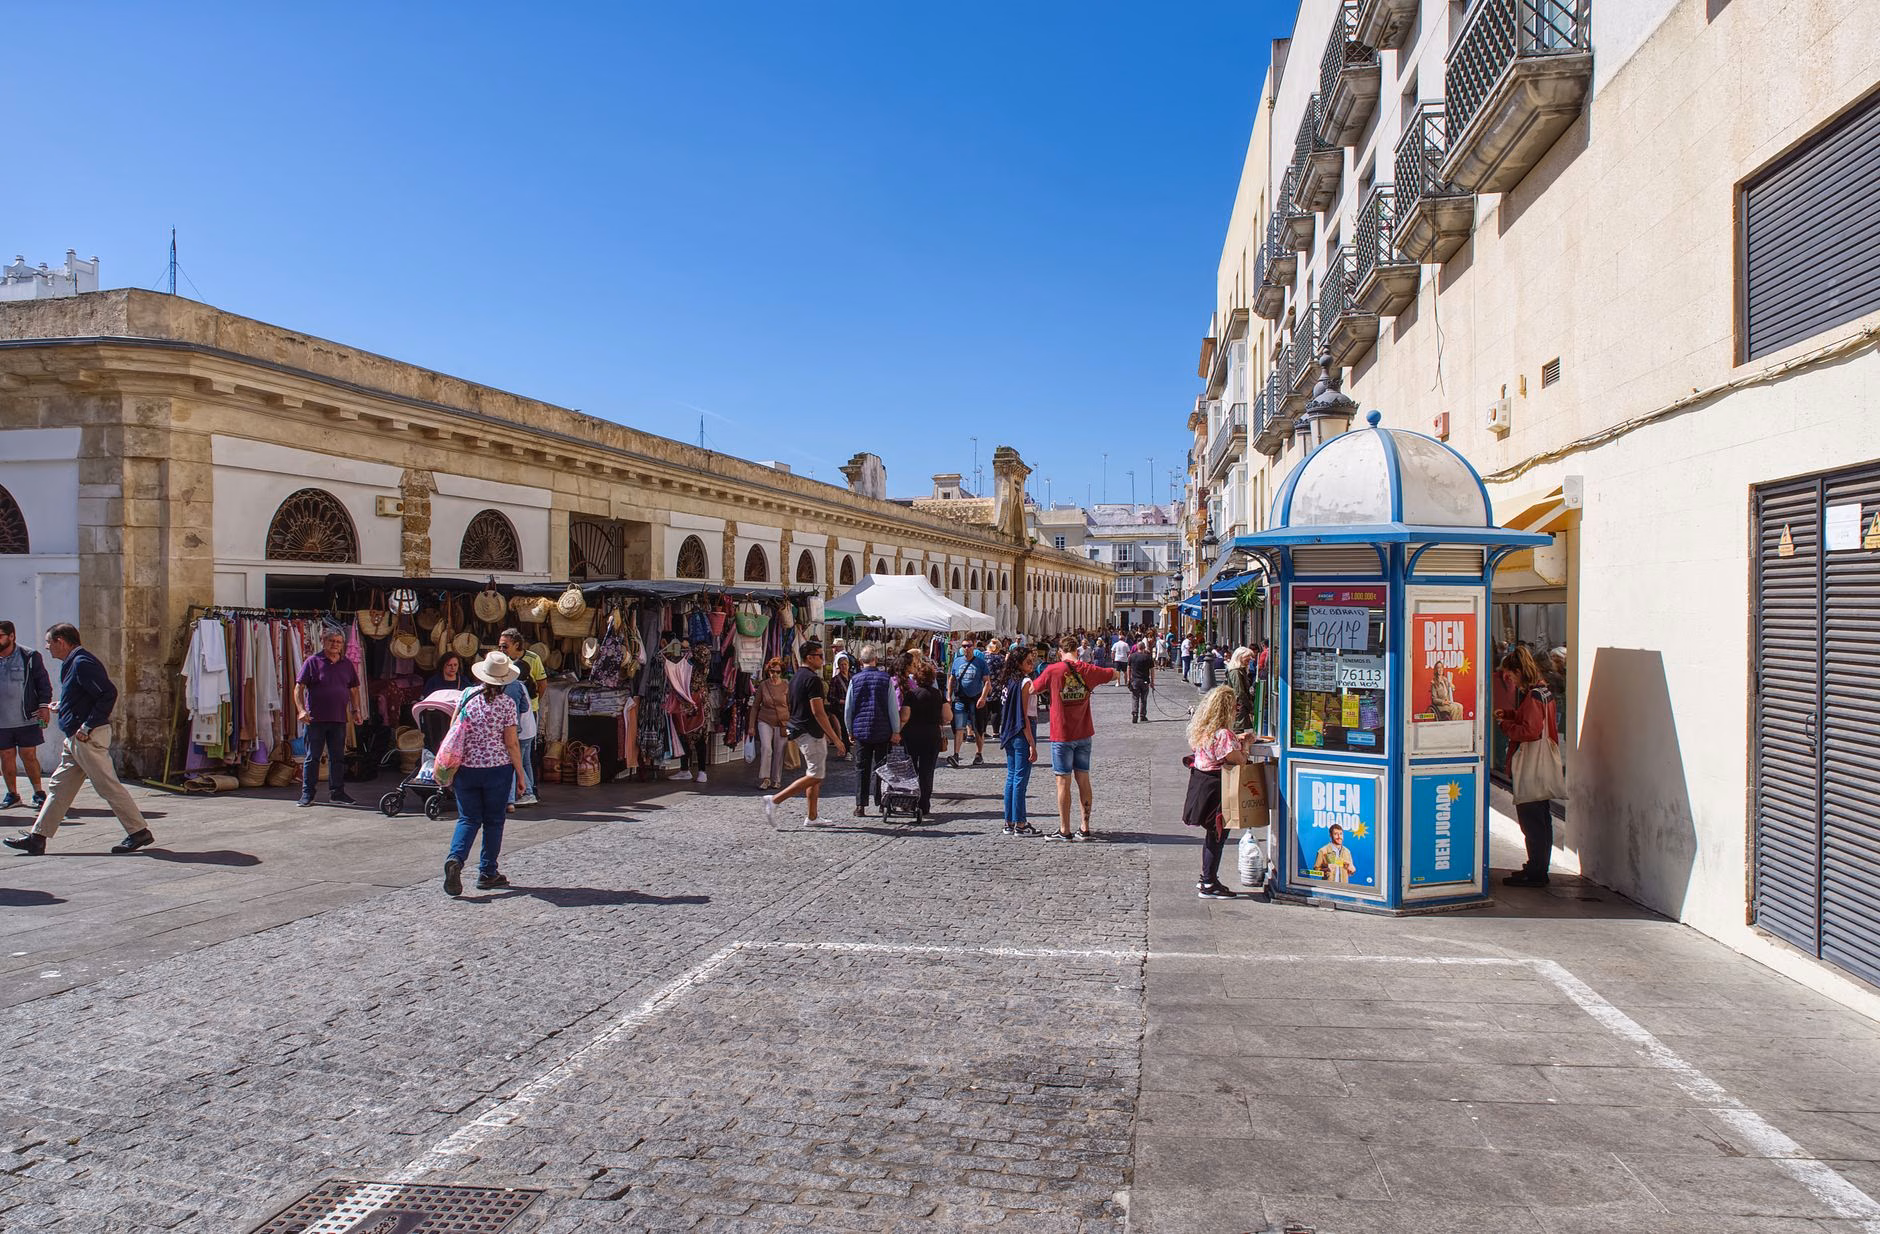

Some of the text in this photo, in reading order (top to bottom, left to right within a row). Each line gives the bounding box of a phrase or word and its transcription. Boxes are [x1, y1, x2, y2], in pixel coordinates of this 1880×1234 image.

[1424, 621, 1464, 650] BIEN
[1425, 651, 1464, 669] JUGADO
[1342, 669, 1382, 681] 76113
[1312, 781, 1360, 814] BIEN
[1312, 811, 1360, 832] JUGADO
[1435, 785, 1451, 870] BIEN JUGADO
